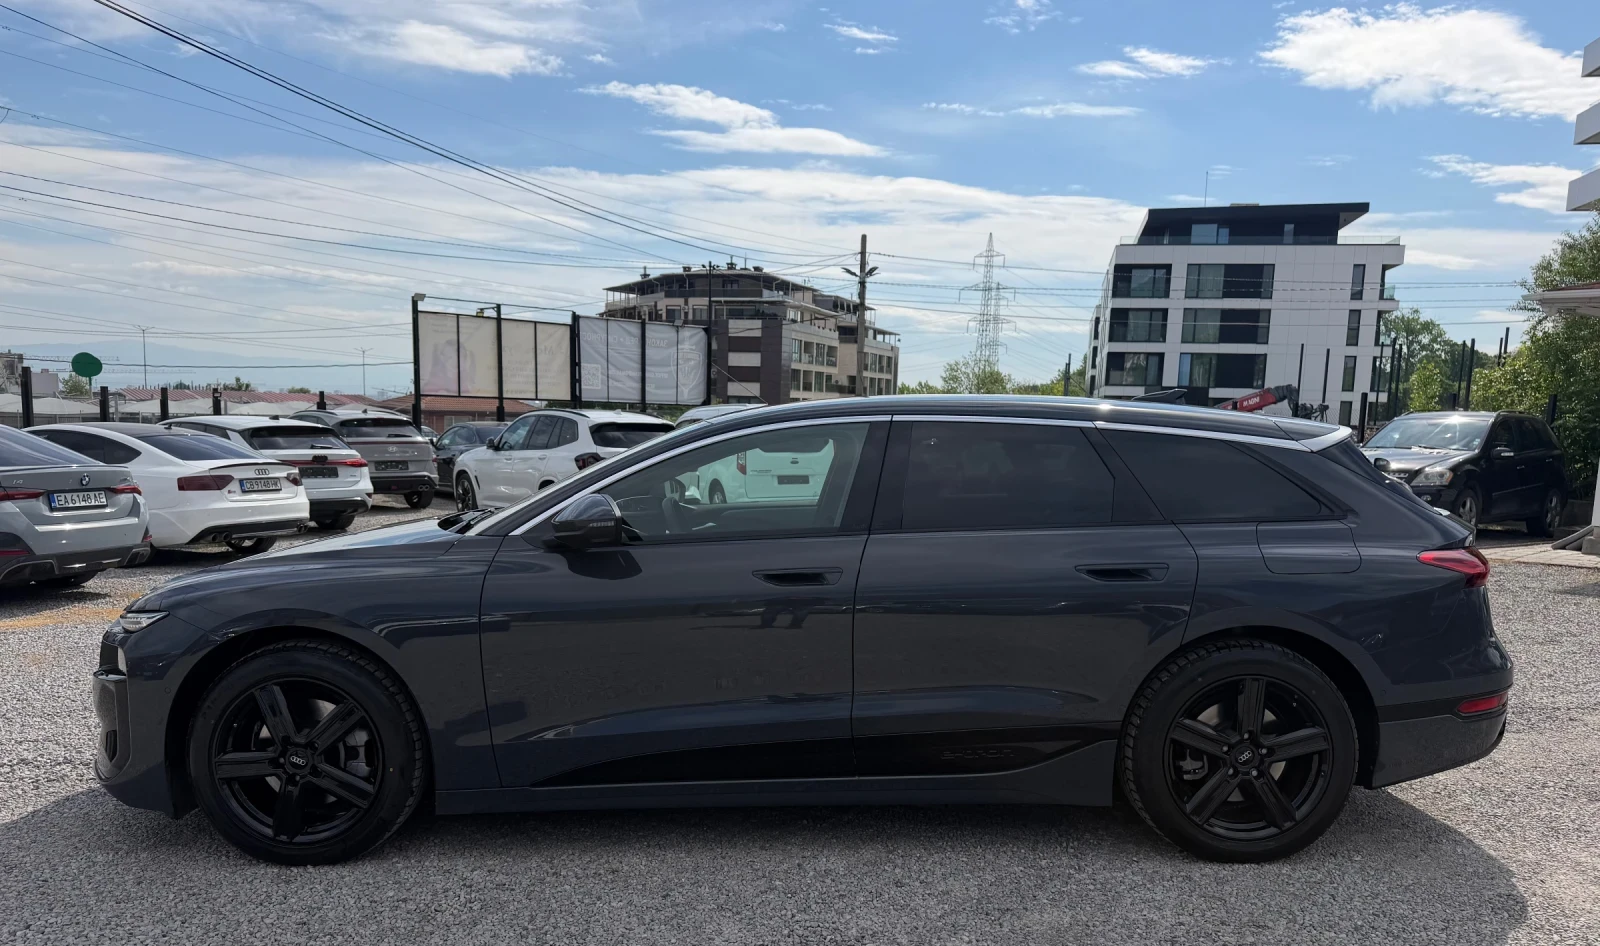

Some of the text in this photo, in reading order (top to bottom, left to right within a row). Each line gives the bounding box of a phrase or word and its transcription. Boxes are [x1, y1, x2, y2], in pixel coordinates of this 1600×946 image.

[56, 492, 106, 506] EA 6148 AE
